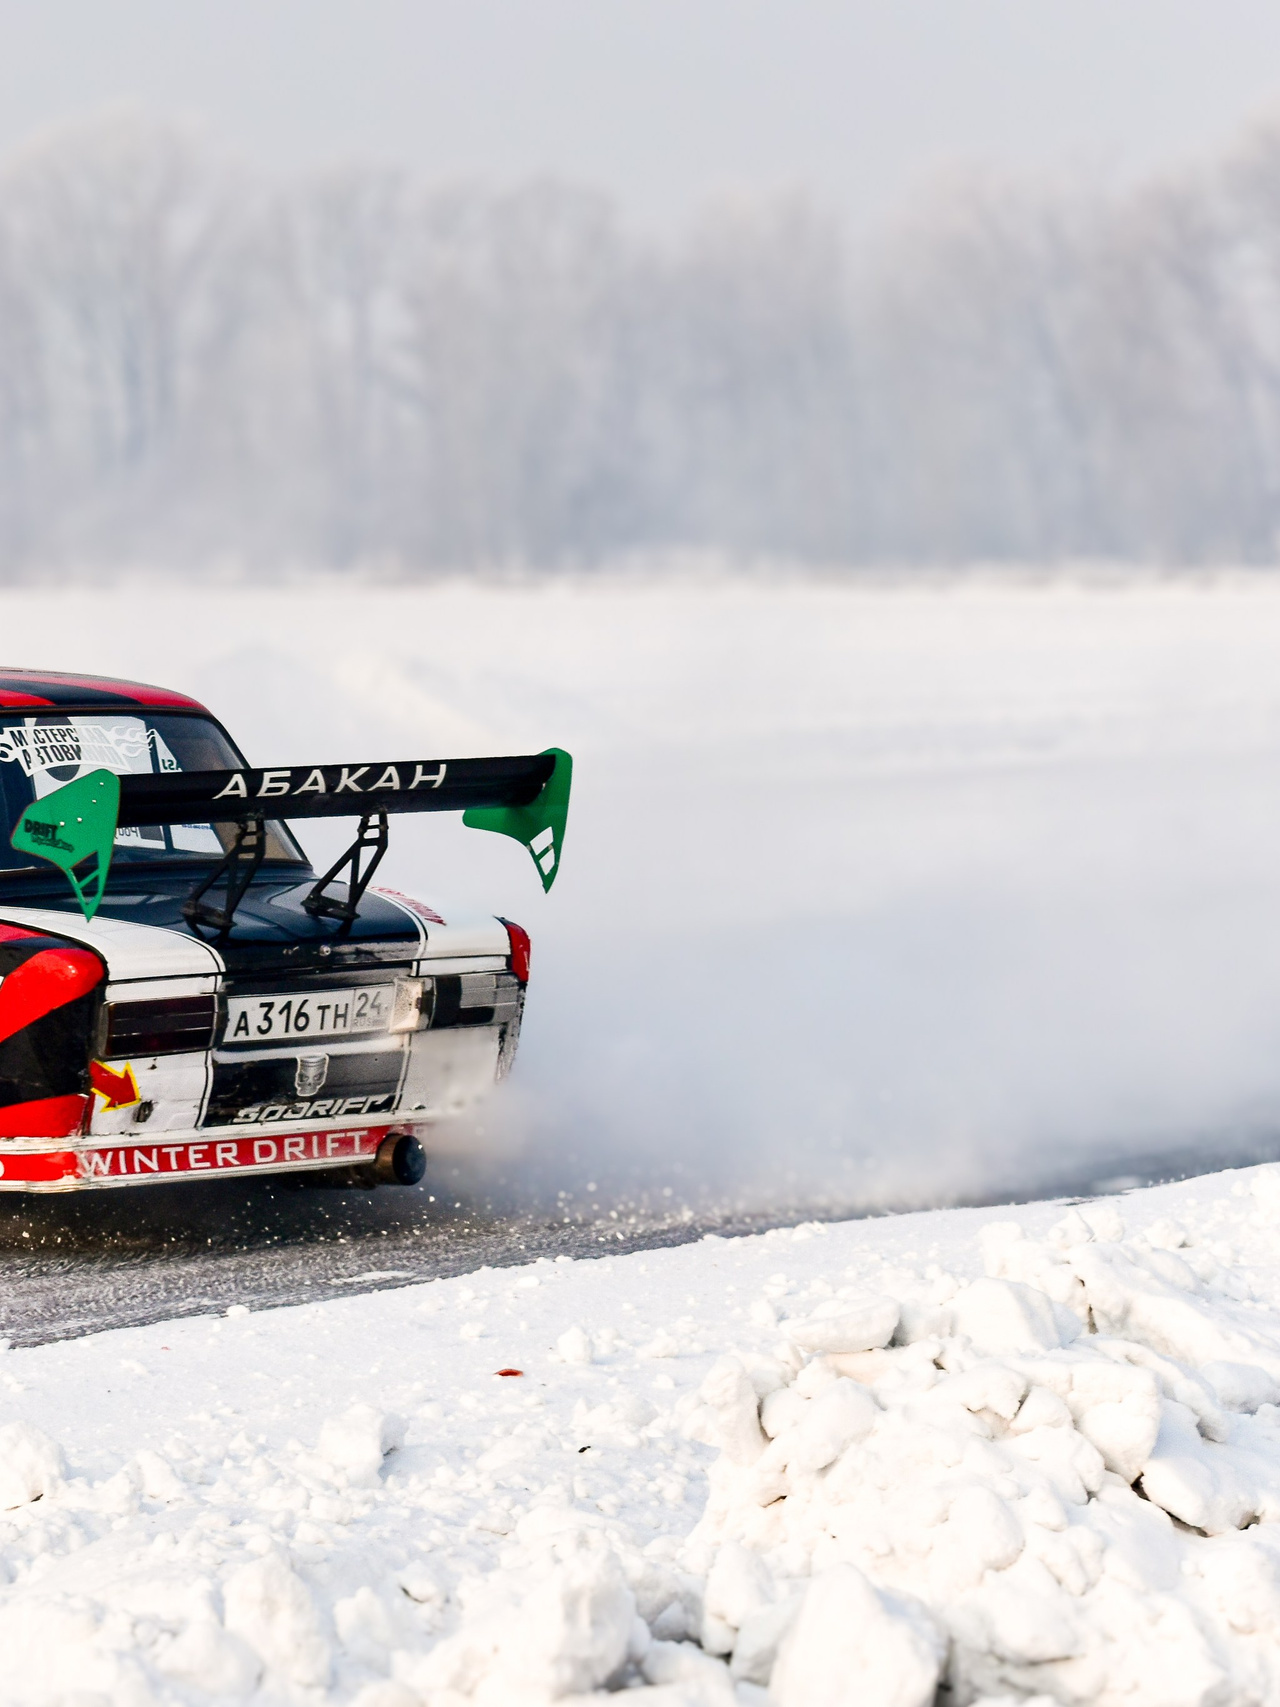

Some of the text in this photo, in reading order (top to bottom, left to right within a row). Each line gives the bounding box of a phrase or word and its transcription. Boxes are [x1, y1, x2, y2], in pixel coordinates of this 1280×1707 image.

[212, 763, 447, 799] АБАКАН
[24, 818, 59, 841] DRIFT
[355, 991, 381, 1018] 24
[79, 1130, 369, 1177] WINTER DRIFT
